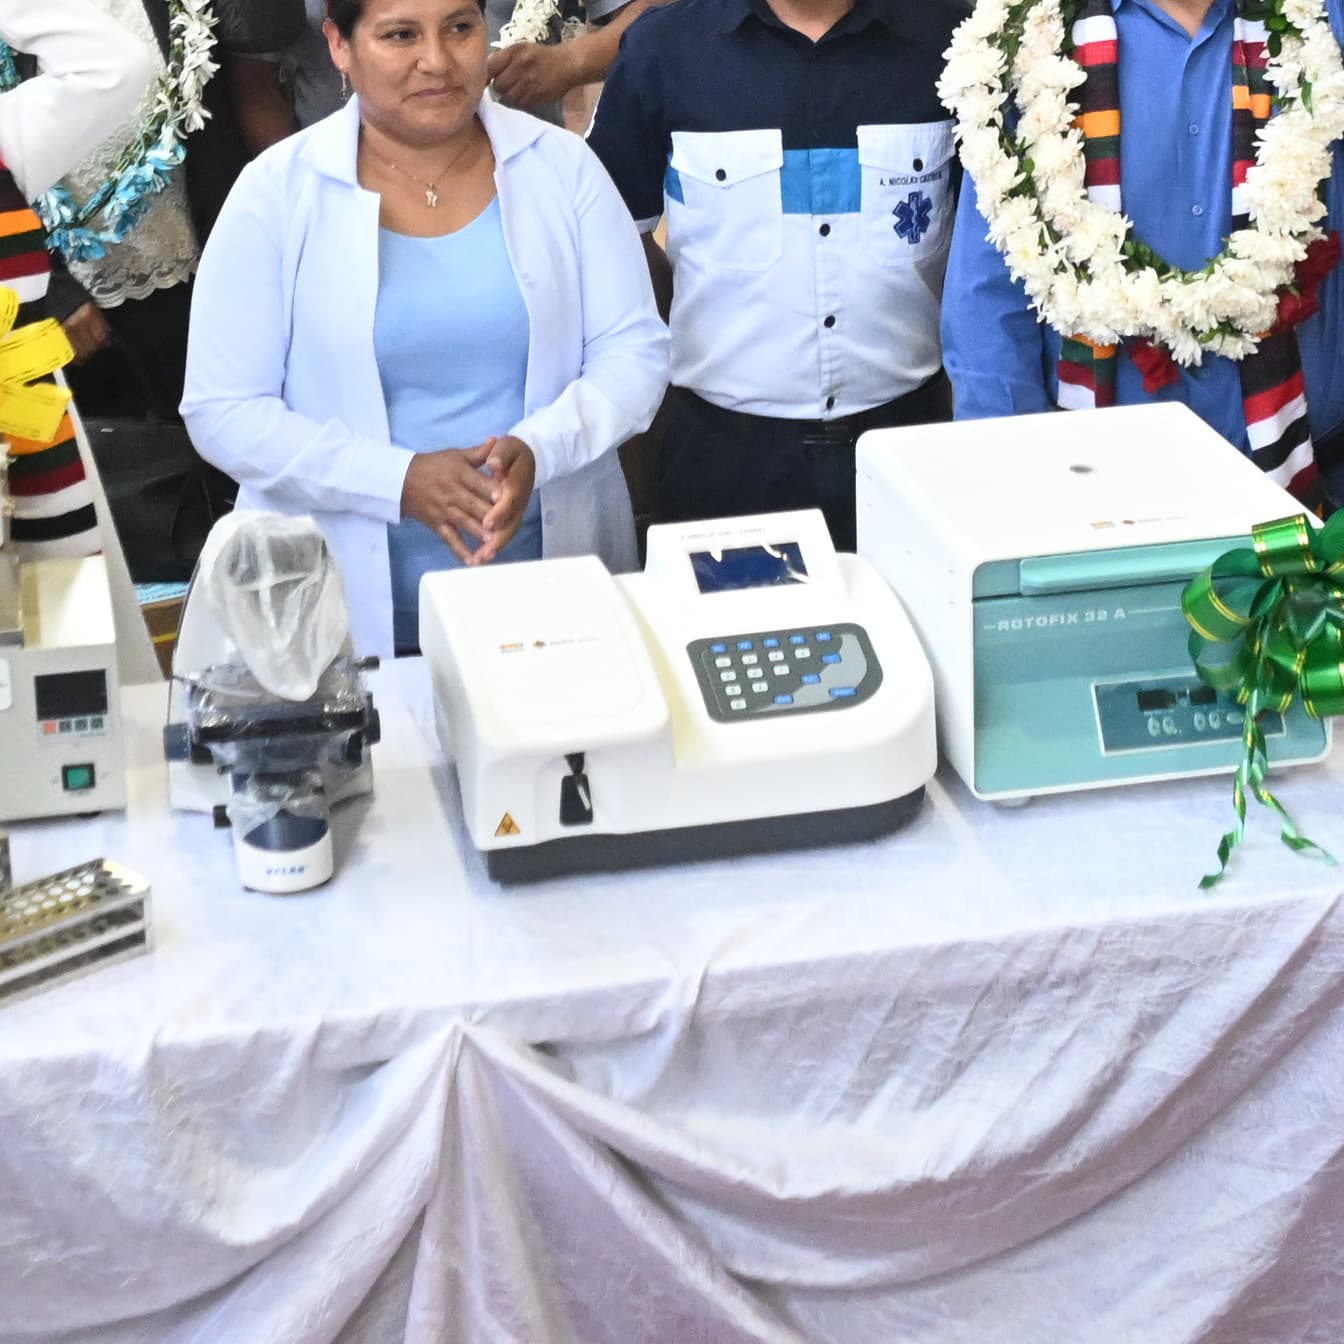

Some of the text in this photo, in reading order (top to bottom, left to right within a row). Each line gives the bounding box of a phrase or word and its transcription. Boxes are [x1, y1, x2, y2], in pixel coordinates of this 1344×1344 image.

[997, 607, 1127, 631] ROTOFIX 32 A
